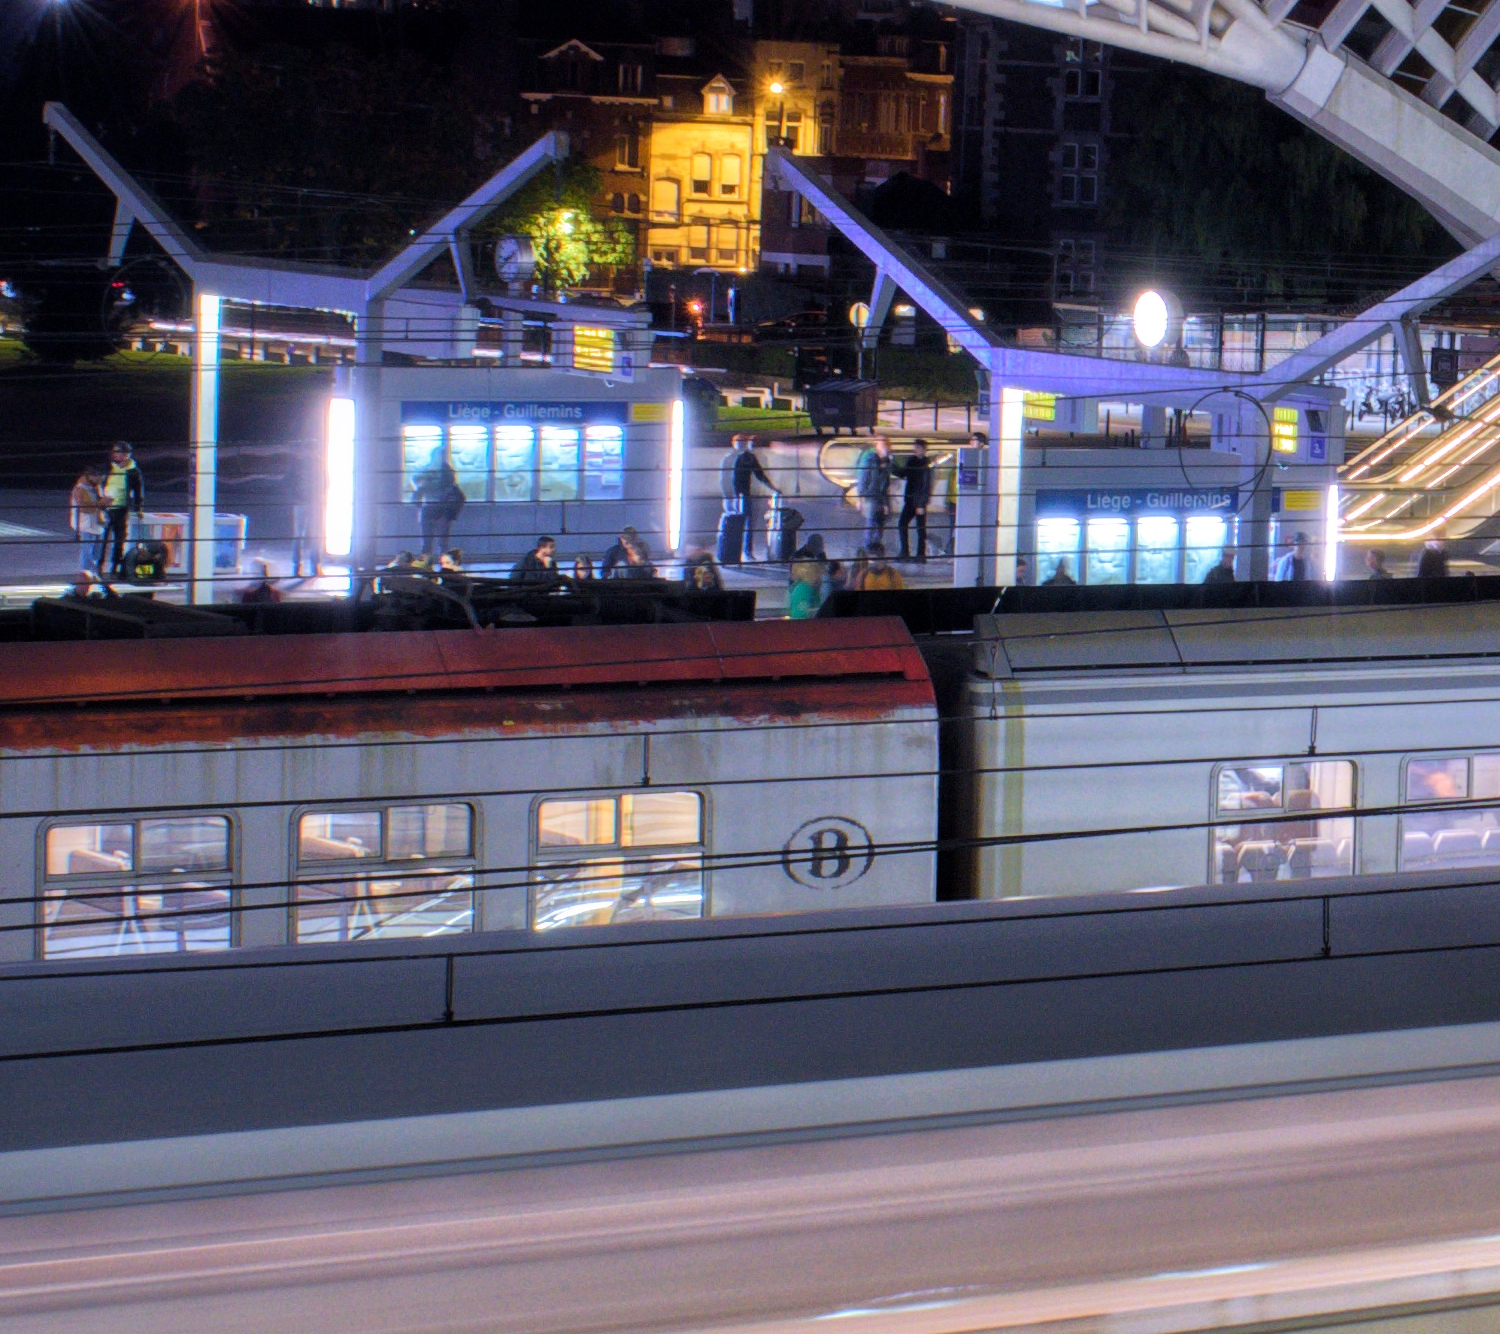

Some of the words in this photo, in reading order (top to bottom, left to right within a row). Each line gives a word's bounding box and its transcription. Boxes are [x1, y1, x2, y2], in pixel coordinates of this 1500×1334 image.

[449, 404, 490, 420] Liège
[504, 403, 582, 418] Guillemins
[1087, 493, 1131, 512] Liège
[1146, 491, 1232, 508] Guillemins
